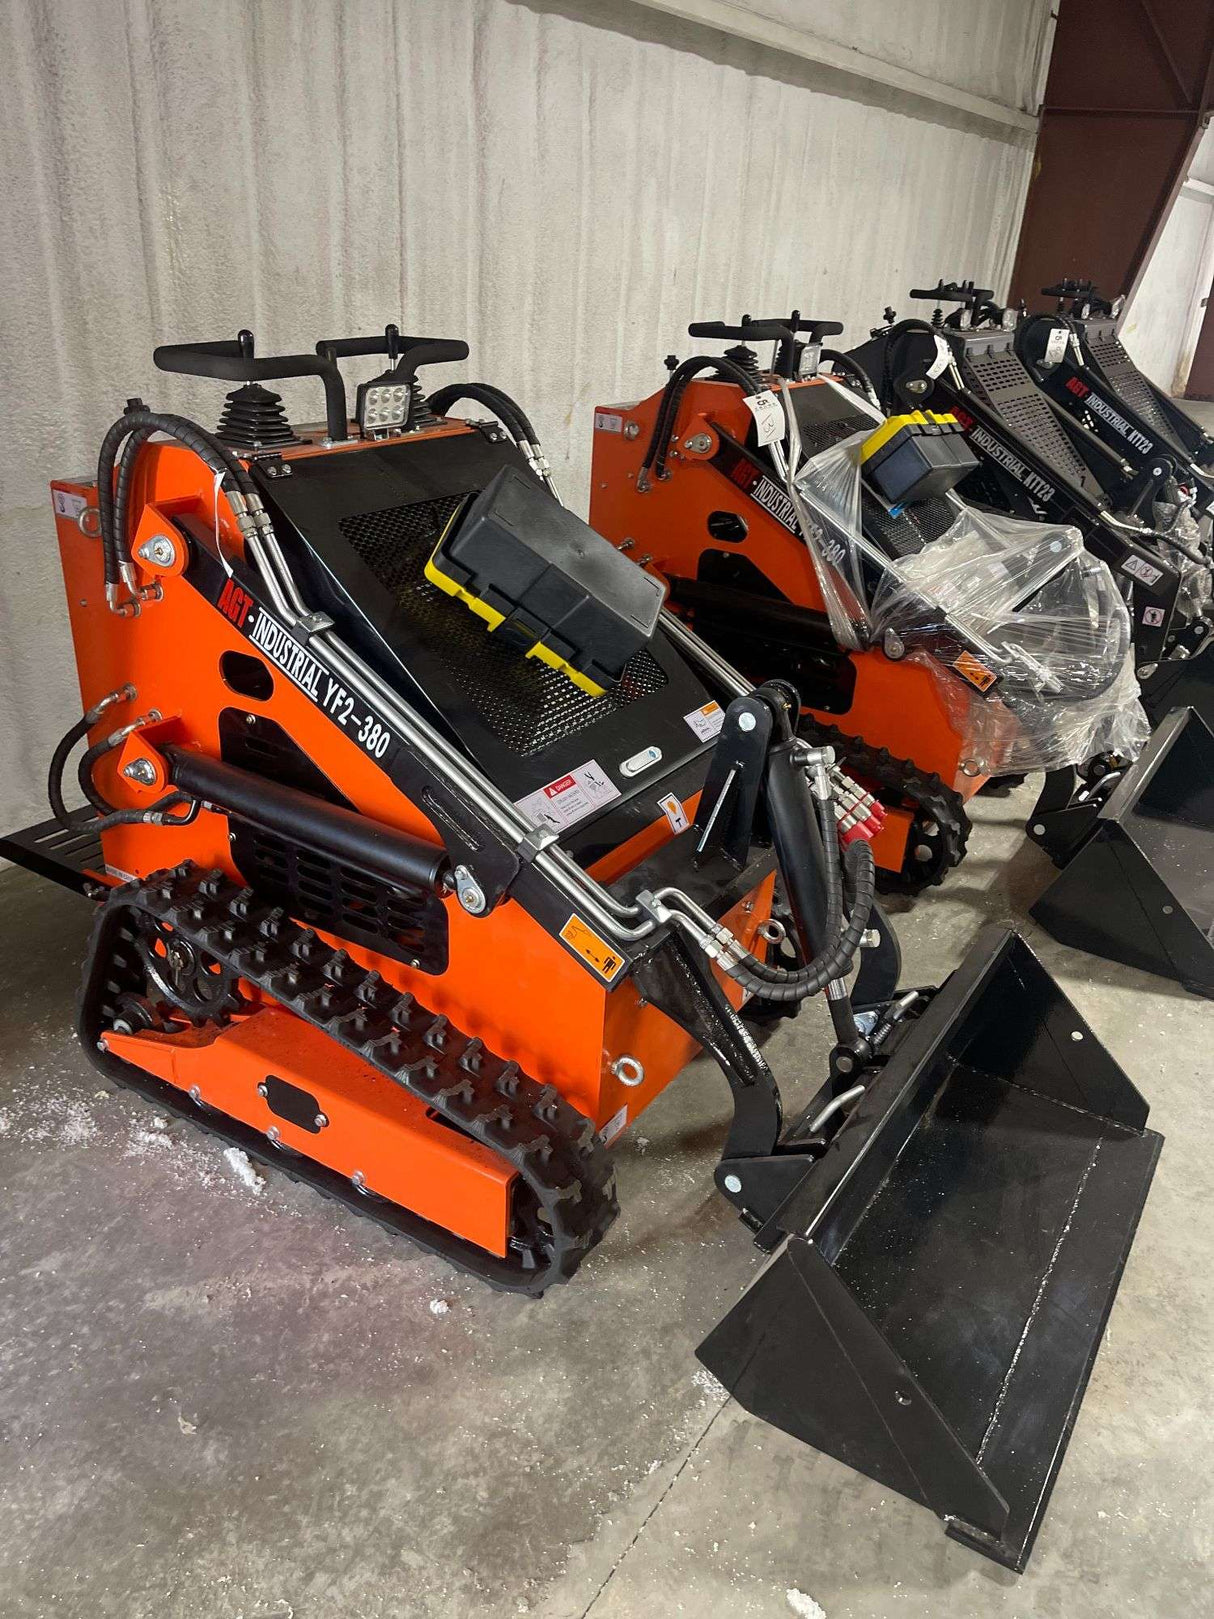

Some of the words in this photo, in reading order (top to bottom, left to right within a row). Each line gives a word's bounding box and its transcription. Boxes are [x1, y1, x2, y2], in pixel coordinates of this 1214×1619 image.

[1085, 393, 1131, 435] INDUSTRIAL
[1126, 429, 1154, 455] KTT23
[970, 427, 1026, 479] INDUSTRIAL
[1023, 471, 1055, 502] KTT23
[752, 478, 798, 531] INDUSTRIAL
[216, 578, 255, 629] AGT
[251, 611, 326, 699] INDUSTRIAL
[321, 677, 391, 759] YF2-380
